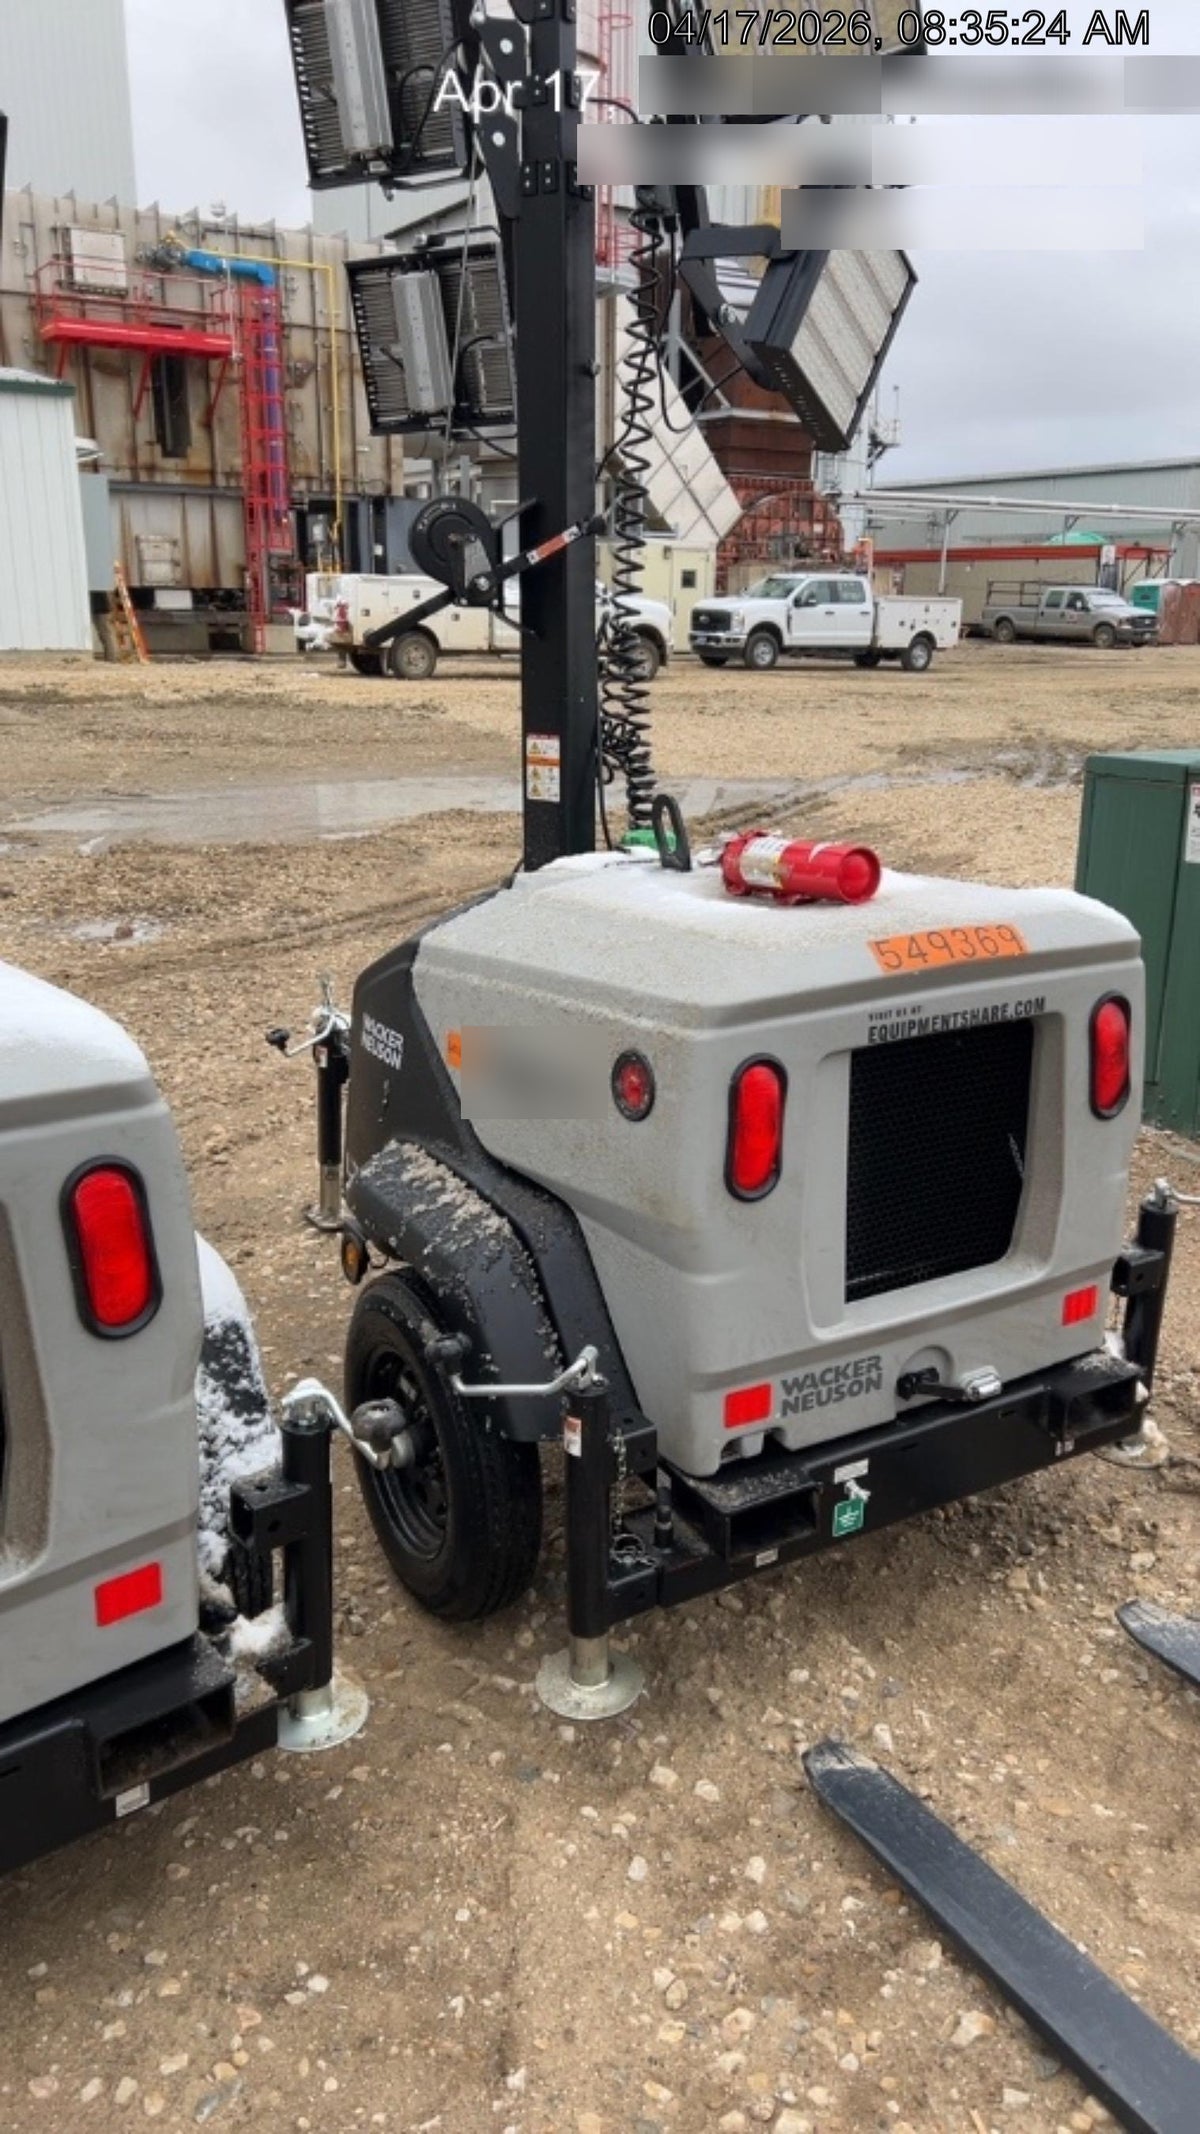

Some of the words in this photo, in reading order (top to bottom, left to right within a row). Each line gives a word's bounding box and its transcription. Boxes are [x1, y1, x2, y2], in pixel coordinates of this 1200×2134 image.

[874, 924, 1024, 971] 549369
[868, 997, 1046, 1044] EQUIPMENTSHARE.COM
[781, 1355, 882, 1397] WACKER
[782, 1373, 883, 1417] NEUSON
